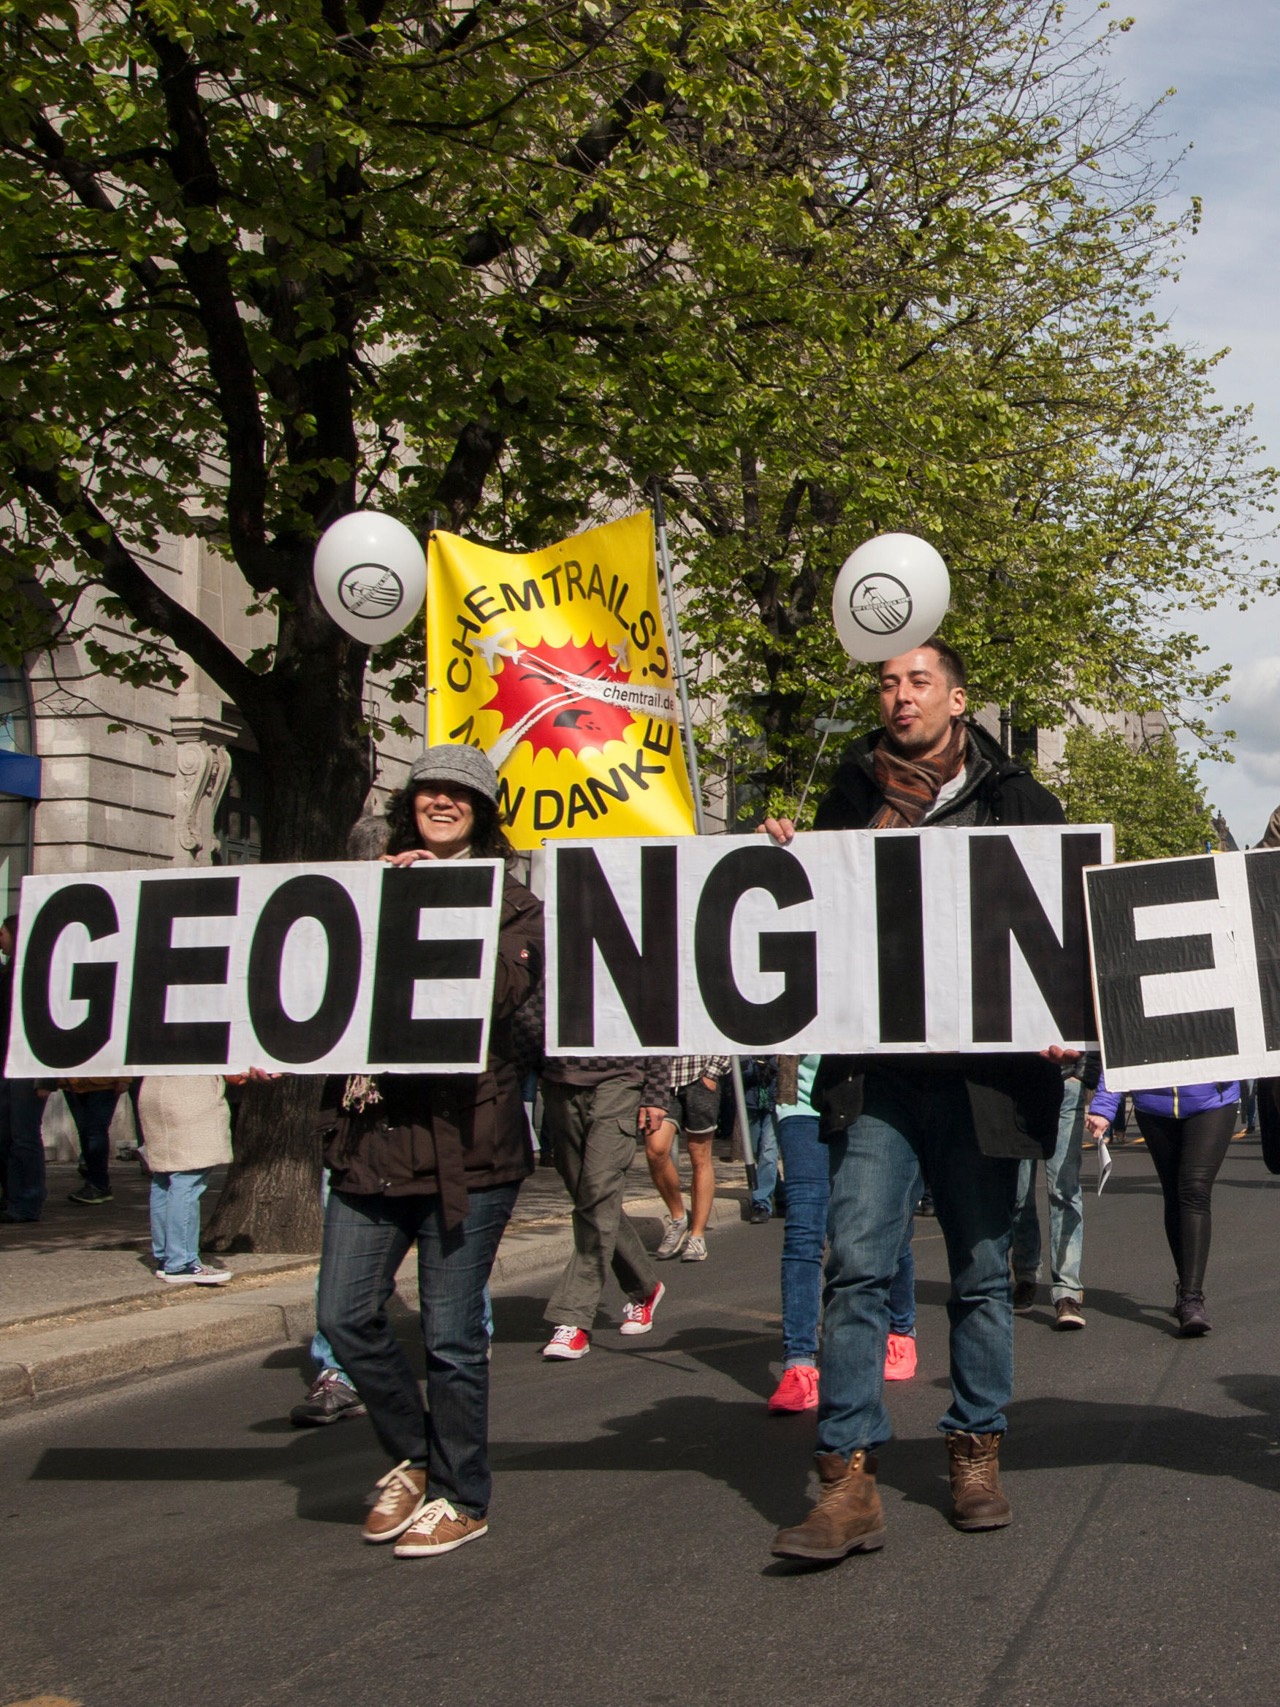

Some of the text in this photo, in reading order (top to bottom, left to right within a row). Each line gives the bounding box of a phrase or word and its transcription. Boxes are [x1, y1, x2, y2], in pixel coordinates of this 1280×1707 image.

[446, 560, 668, 693] CHEMTRAILS?
[602, 685, 674, 711] chemtrail.de
[533, 717, 673, 831] DANKE
